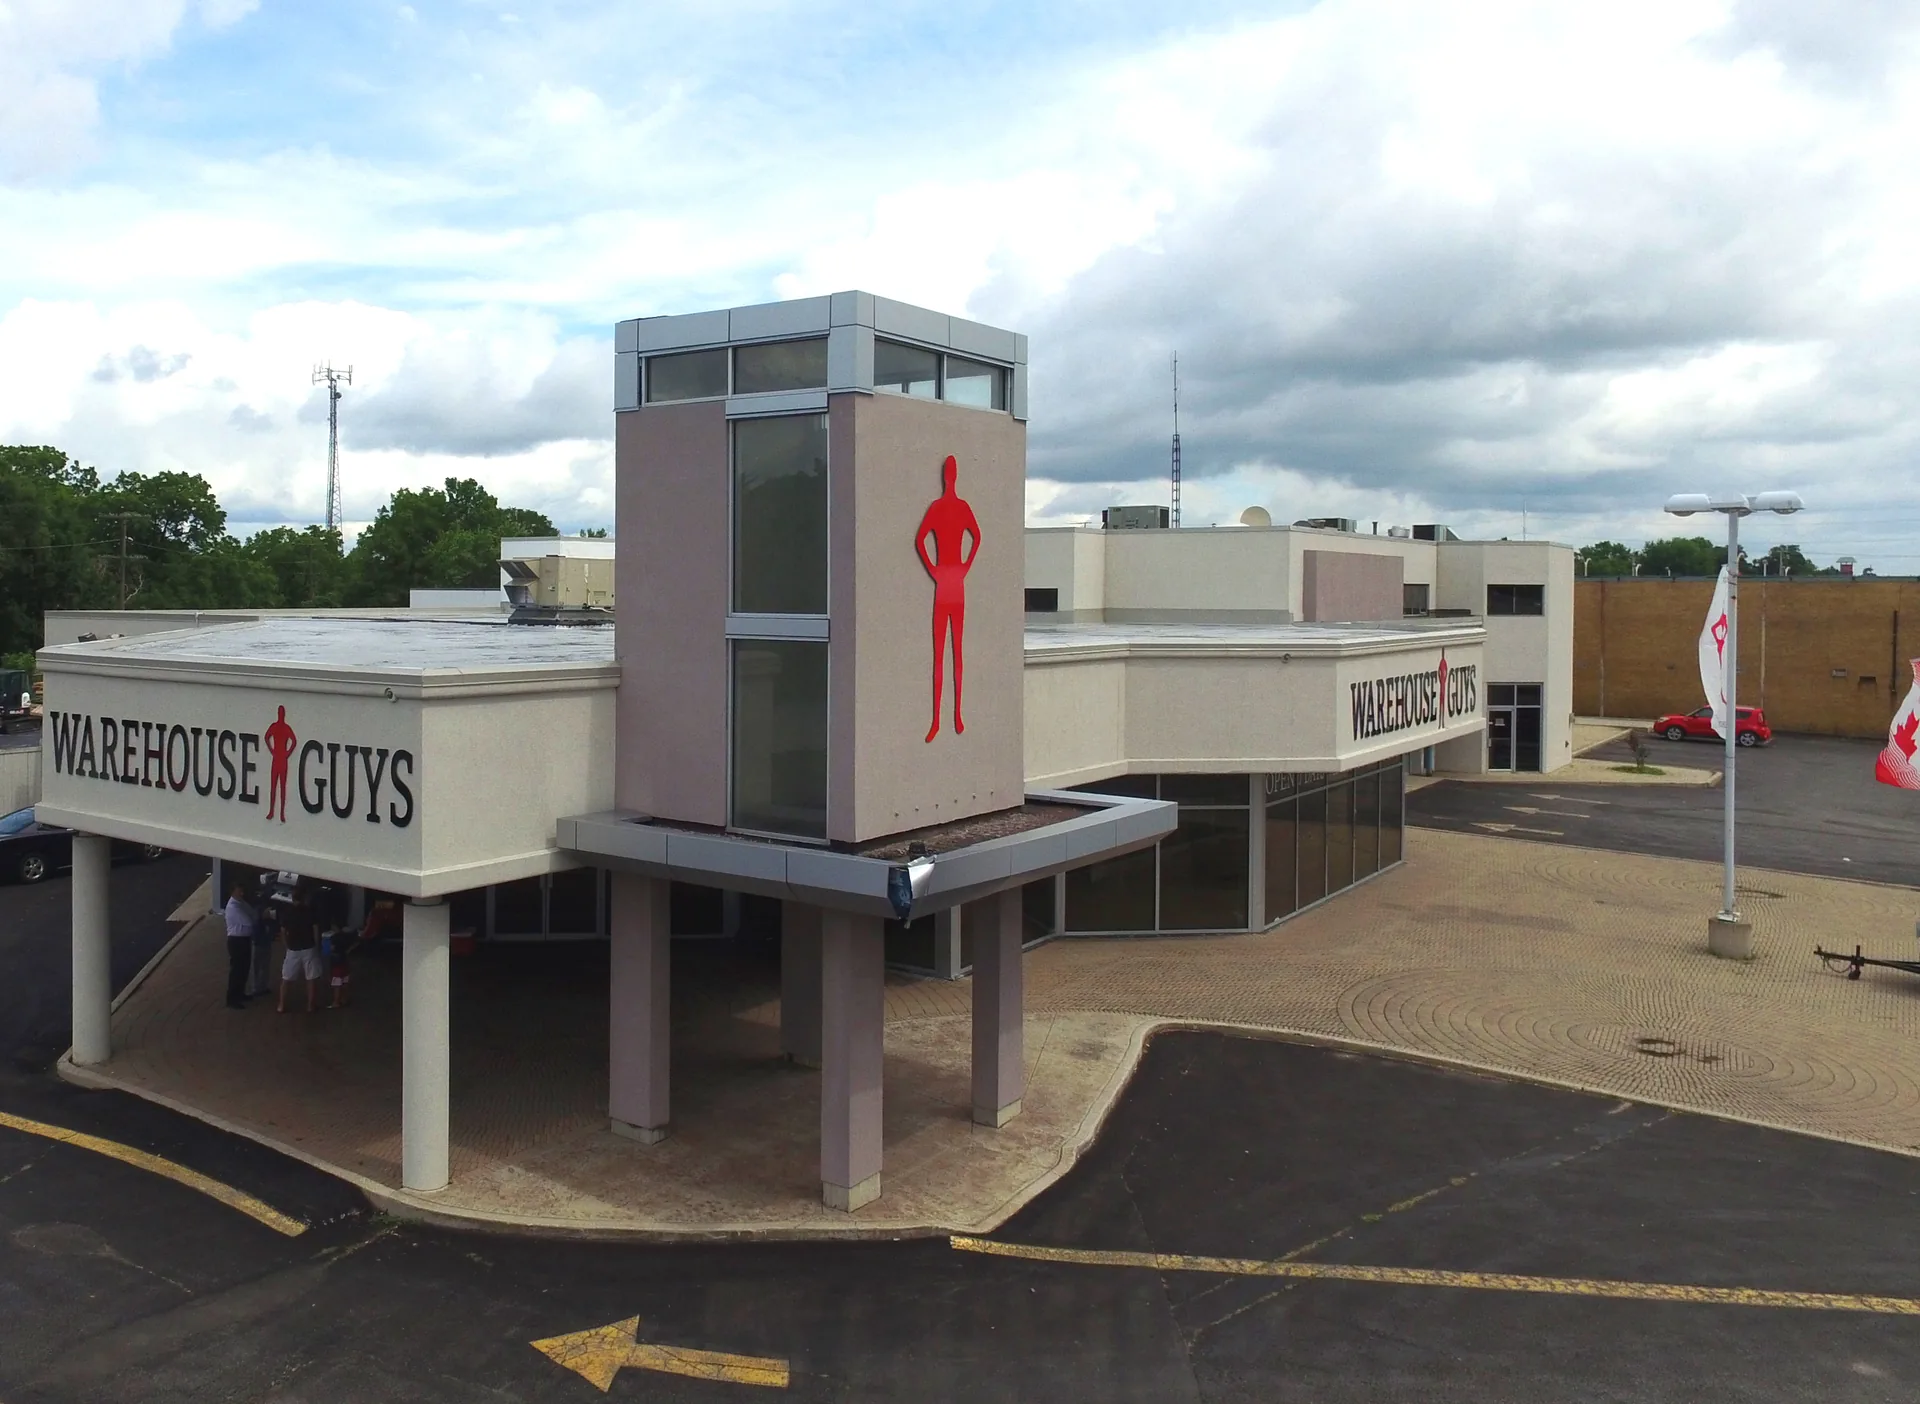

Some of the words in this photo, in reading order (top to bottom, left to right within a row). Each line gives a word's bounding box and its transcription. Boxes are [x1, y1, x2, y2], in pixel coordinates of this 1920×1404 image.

[1350, 670, 1438, 741] WAREHOUSE
[1447, 664, 1477, 718] GUYS
[50, 711, 260, 804] WAREHOUSE
[299, 739, 414, 828] GUYS
[1265, 772, 1295, 795] OPEN
